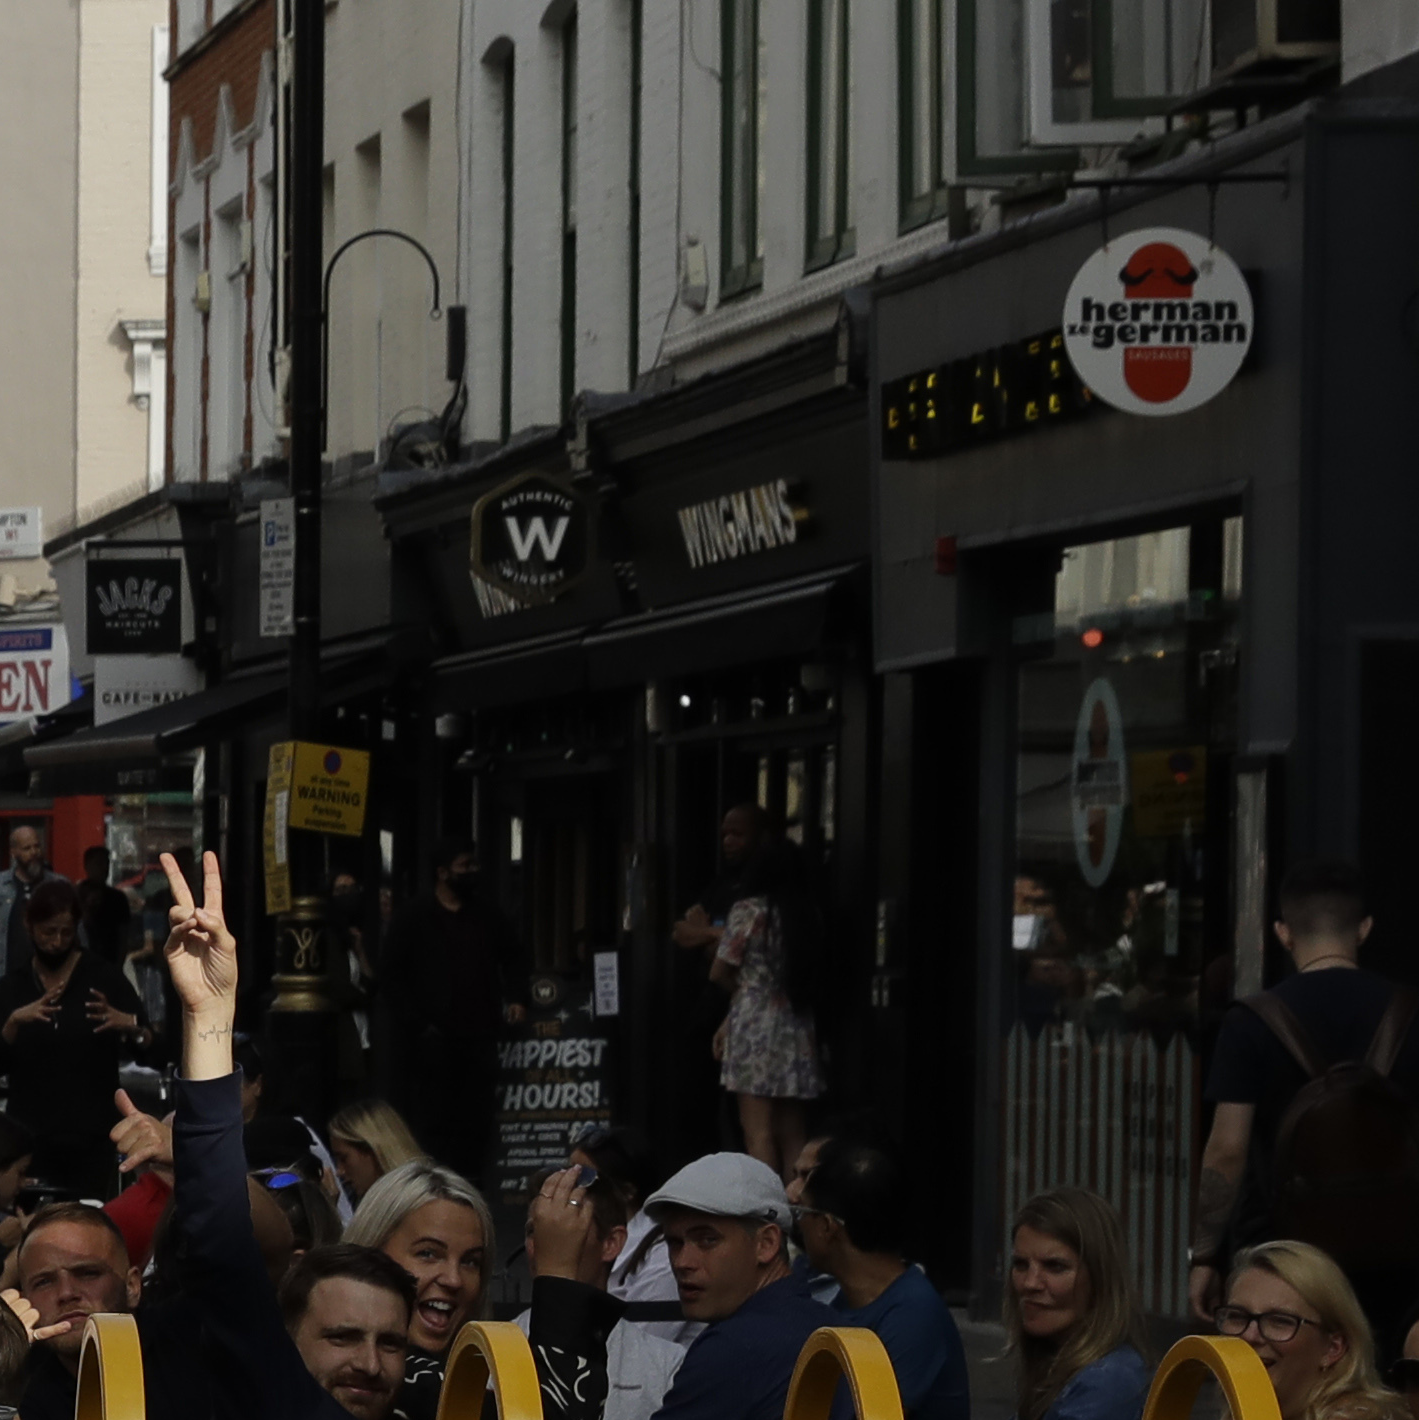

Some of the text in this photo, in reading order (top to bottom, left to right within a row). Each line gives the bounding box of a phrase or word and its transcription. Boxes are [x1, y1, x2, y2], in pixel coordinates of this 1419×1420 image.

[1081, 296, 1238, 323] herman
[1067, 323, 1247, 350] ze german
[500, 490, 574, 512] AUTHENTIC
[677, 478, 797, 569] WINGMANS
[504, 515, 571, 562] W
[94, 576, 174, 617] JACKS
[297, 786, 361, 807] WARNING
[312, 804, 342, 819] Parking
[533, 1020, 563, 1037] THE
[496, 1037, 608, 1069] HAPPIEST
[503, 1079, 601, 1111] HOURS!
